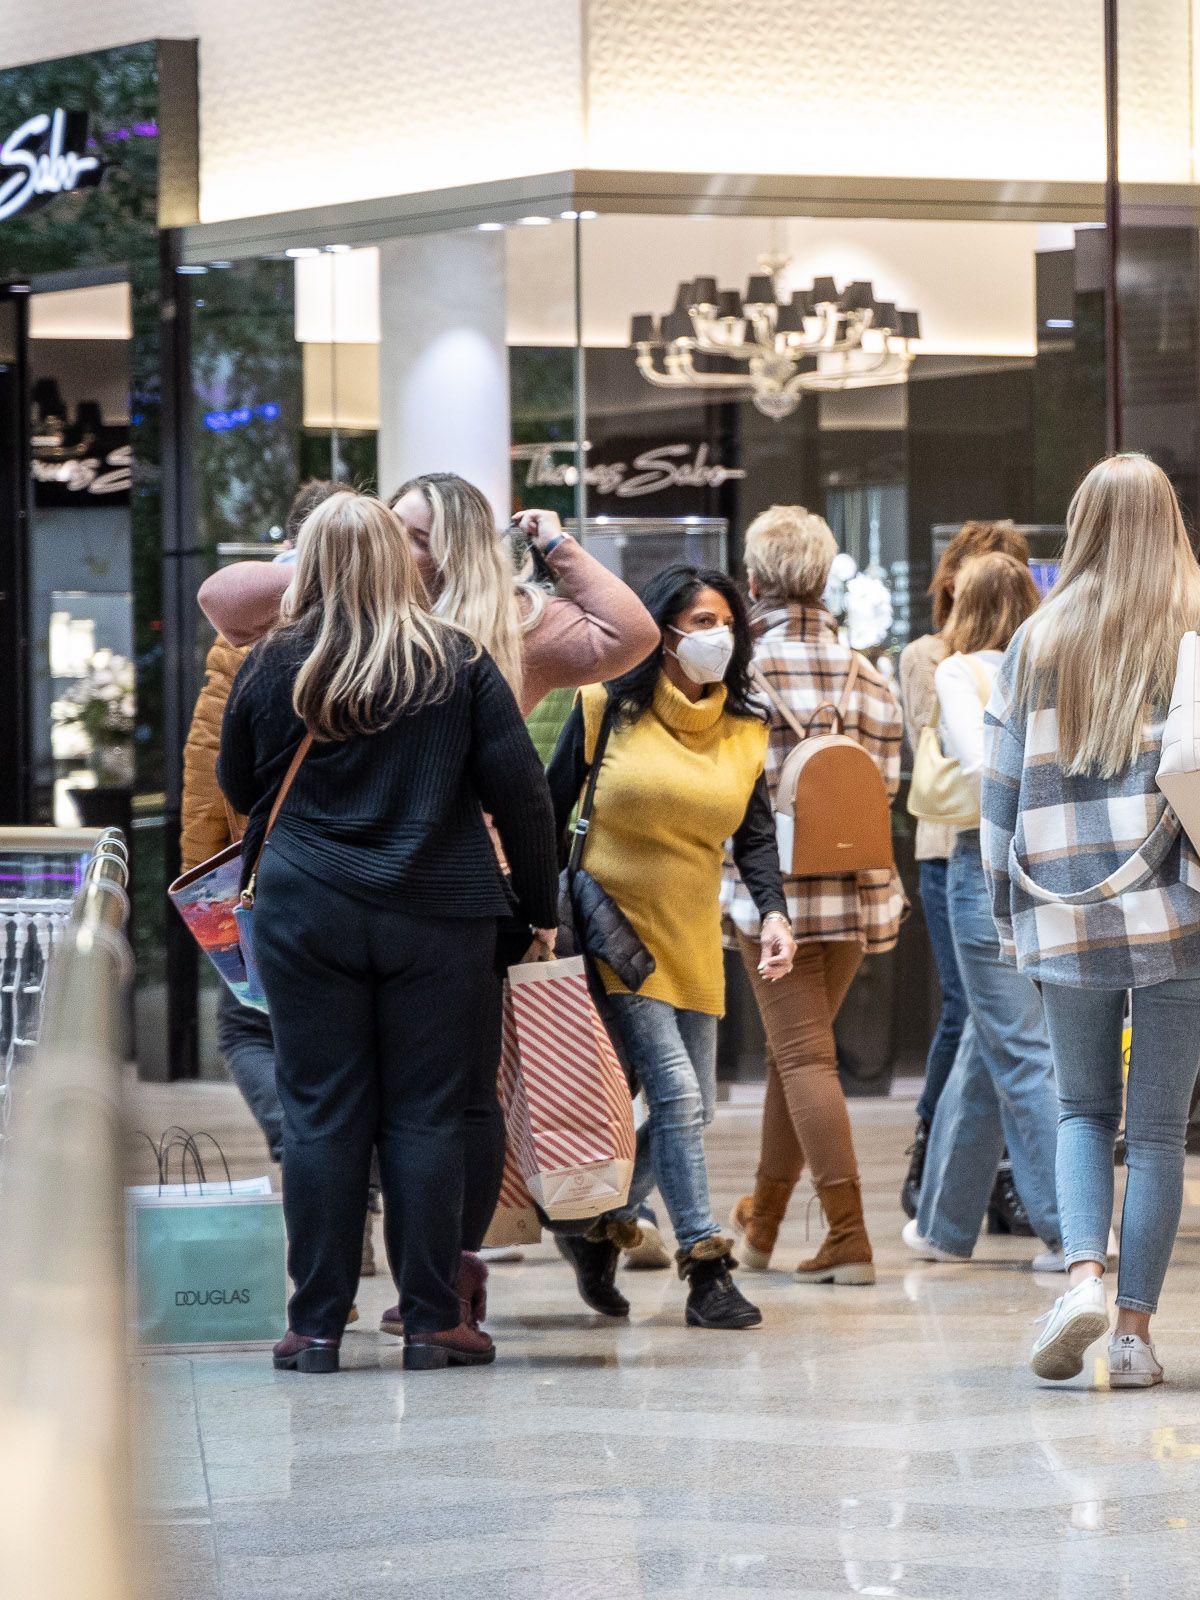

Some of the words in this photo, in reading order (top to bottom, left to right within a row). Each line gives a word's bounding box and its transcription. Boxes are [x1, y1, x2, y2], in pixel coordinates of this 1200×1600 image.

[0, 107, 98, 222] Sabo
[615, 441, 747, 498] Sabo
[175, 1288, 250, 1306] DOUGLAS
